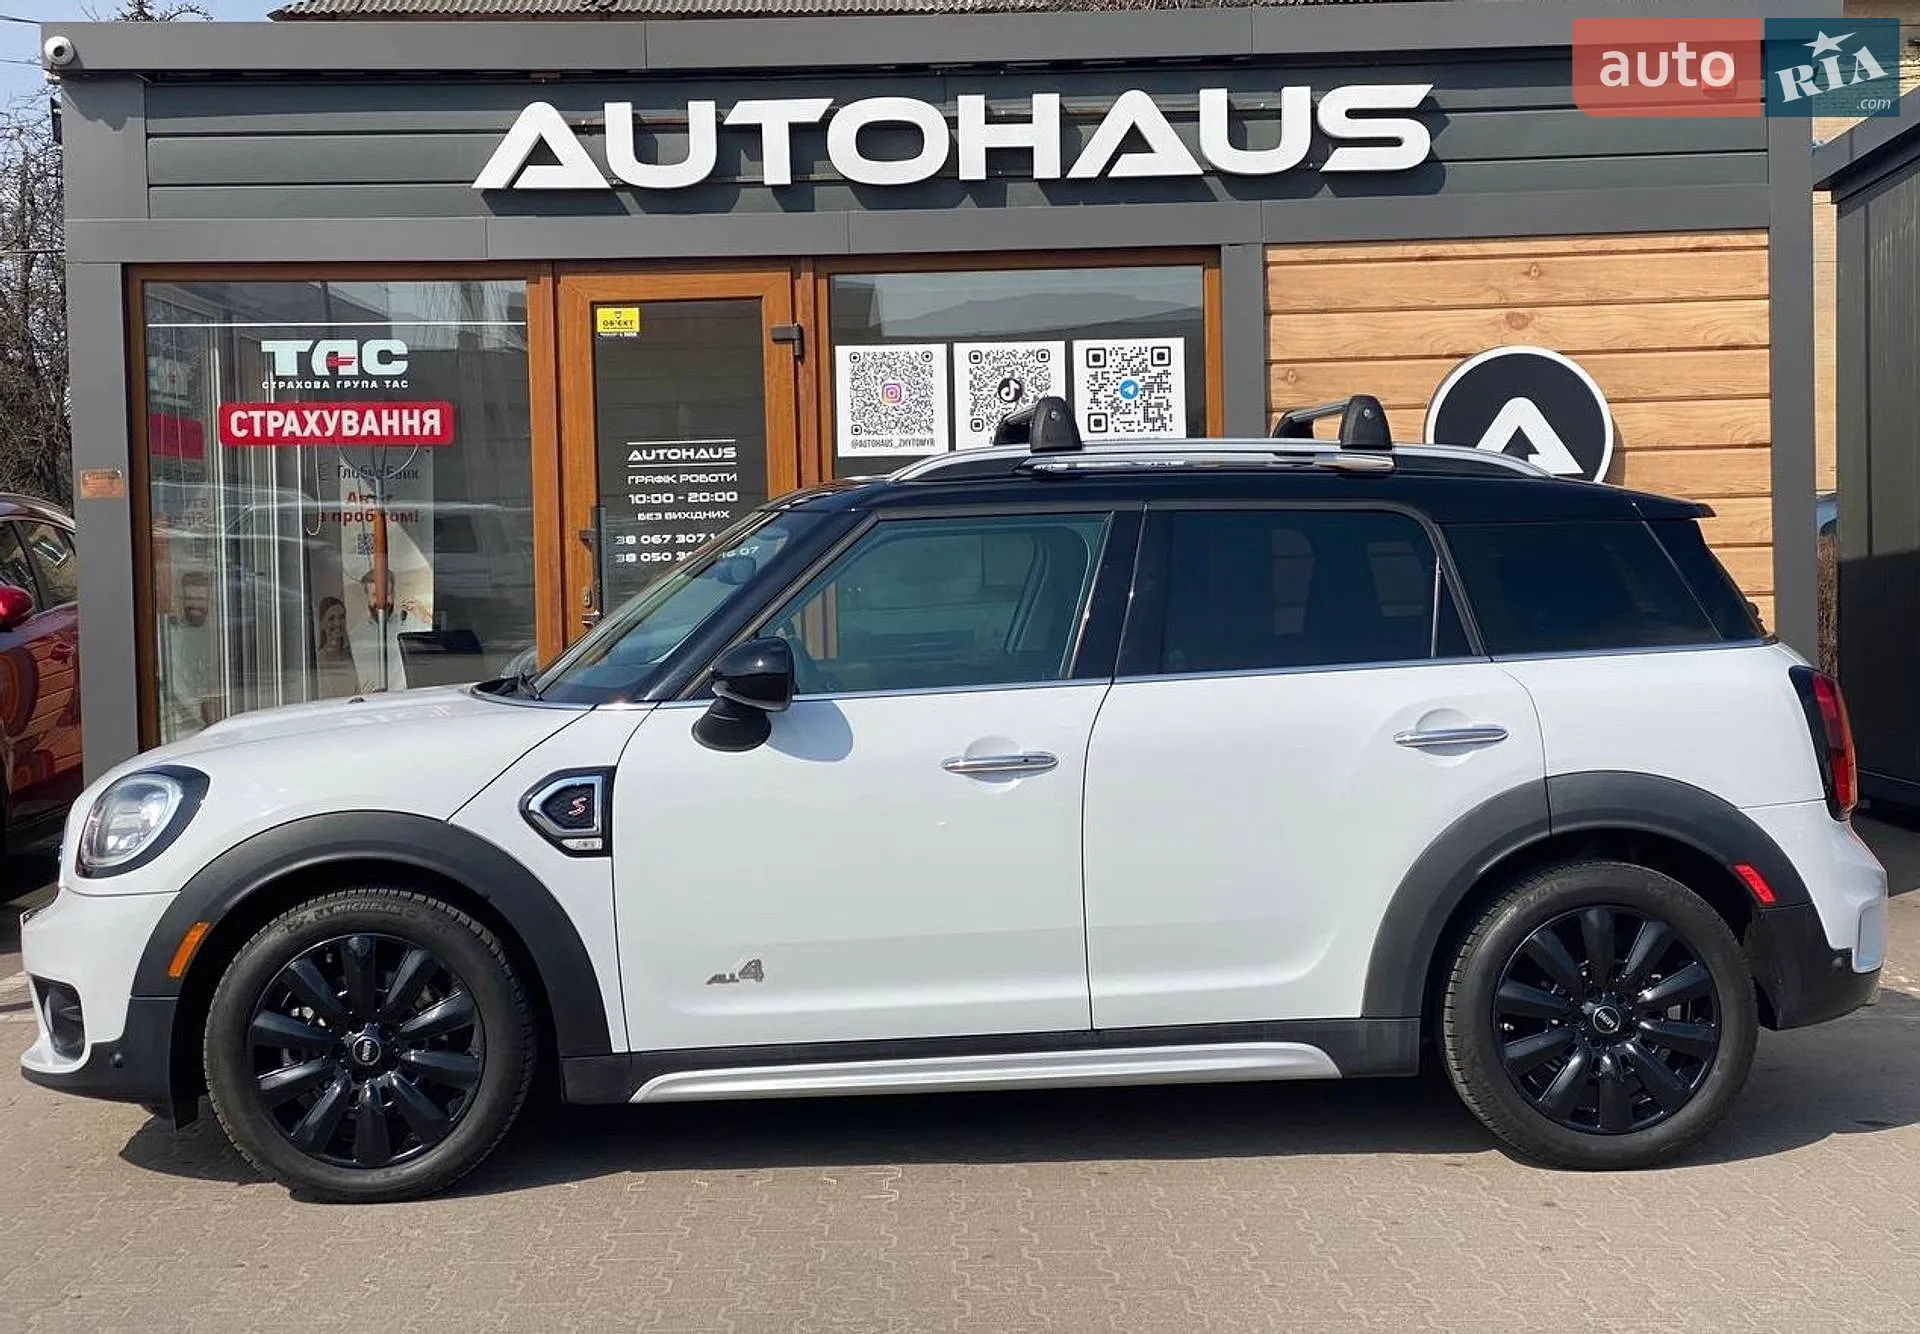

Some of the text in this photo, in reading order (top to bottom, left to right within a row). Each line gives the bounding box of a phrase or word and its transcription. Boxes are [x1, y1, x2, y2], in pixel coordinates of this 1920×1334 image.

[472, 84, 1434, 190] AUTOHAUS
[261, 339, 408, 376] ТАС
[262, 379, 409, 389] СТРАХОВА ГРУПА ТАС
[230, 408, 441, 438] СТРАХУВАННЯ
[628, 447, 737, 461] AUTOHAUS
[628, 472, 738, 485] ГРАФІК РОБОТИ
[628, 493, 675, 504] 10:00
[687, 491, 738, 503] 20:00
[637, 510, 730, 521] БЕЗ ВИХІДНИХ
[640, 534, 671, 544] 067
[675, 533, 706, 543] 307
[640, 551, 672, 562] 050
[568, 797, 587, 816] S
